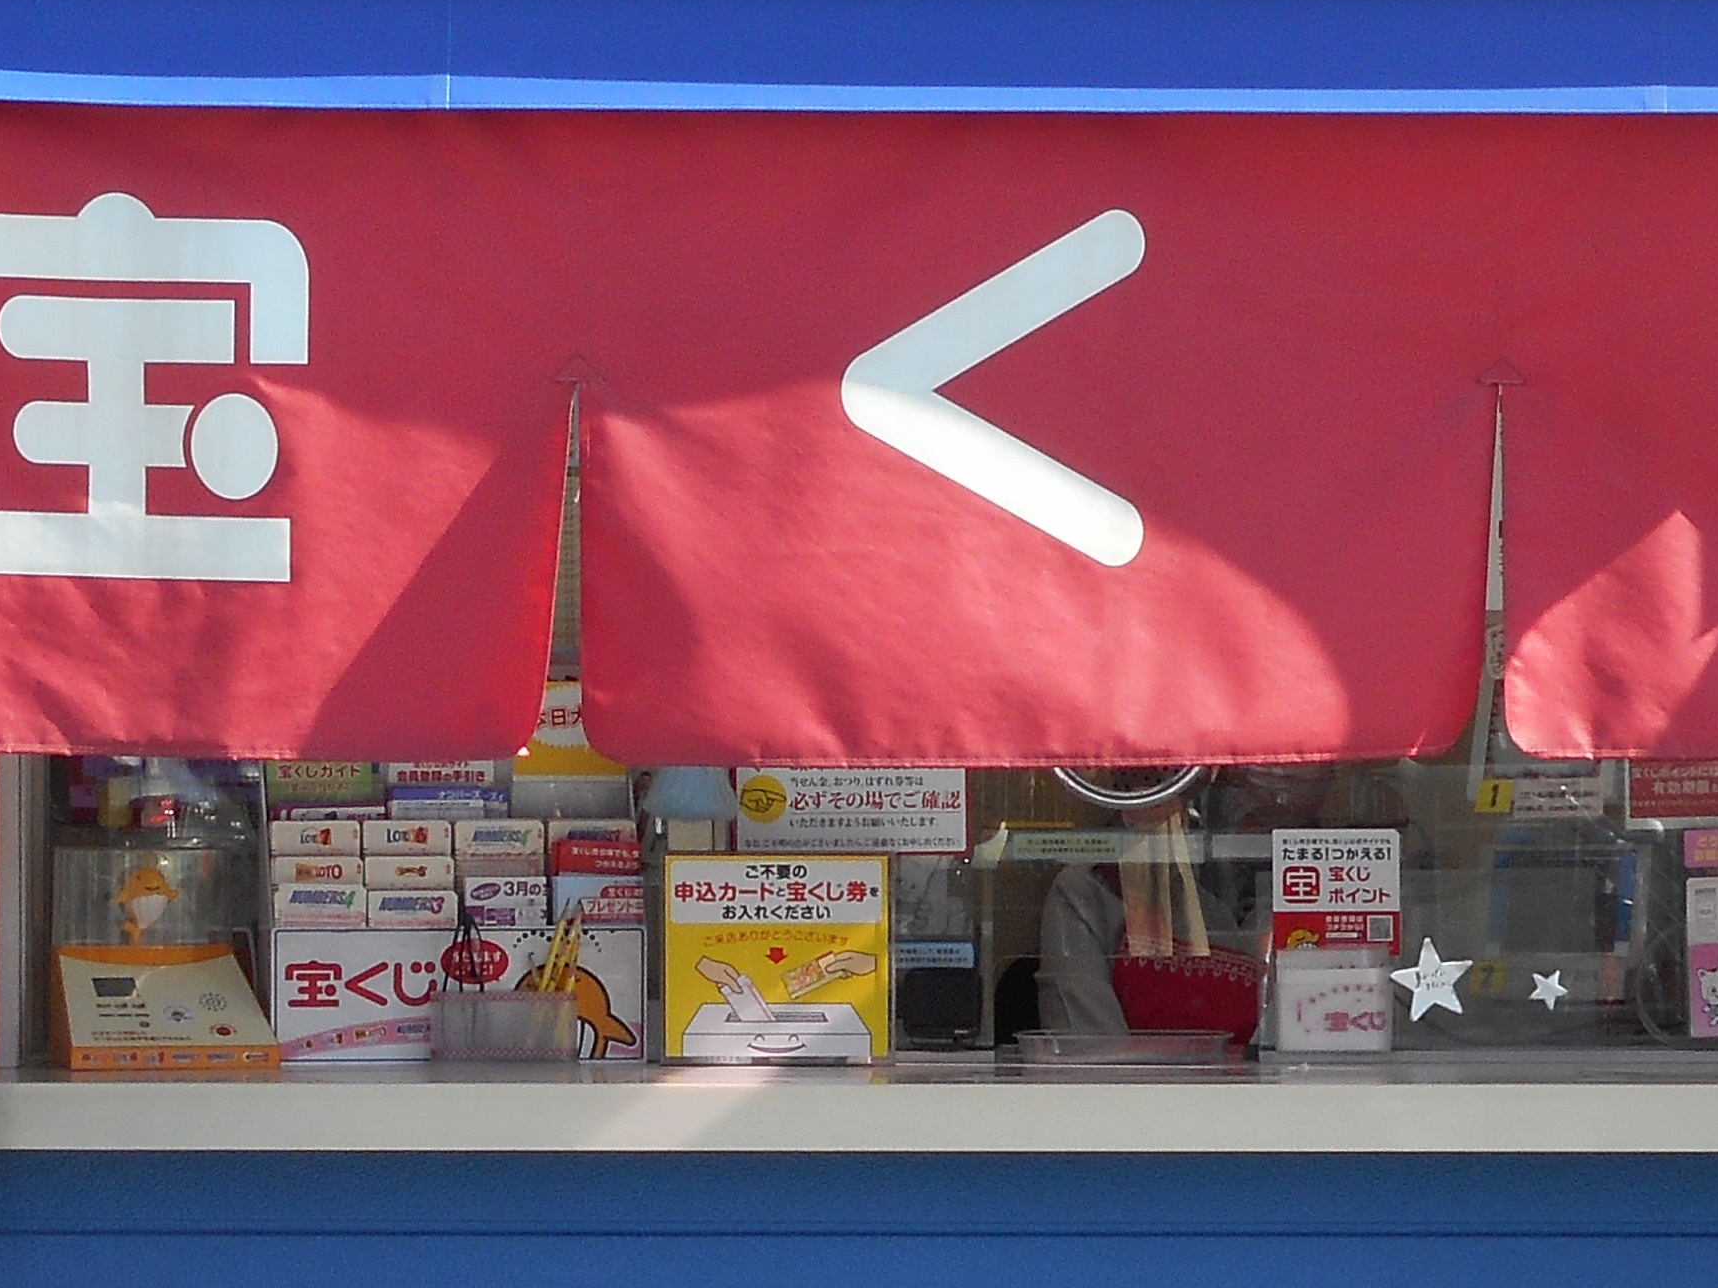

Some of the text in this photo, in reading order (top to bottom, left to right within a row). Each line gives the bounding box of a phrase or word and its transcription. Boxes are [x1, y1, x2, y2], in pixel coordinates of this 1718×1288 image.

[789, 790, 962, 811] 必ずその場でご確認
[744, 864, 808, 880] ご不要の
[1328, 865, 1371, 883] 宝くじ
[674, 881, 880, 903] 申込カードと宝くじ券を
[1328, 887, 1391, 904] ポイント
[721, 905, 832, 920] お入れください
[284, 959, 437, 1008] 宝くじ
